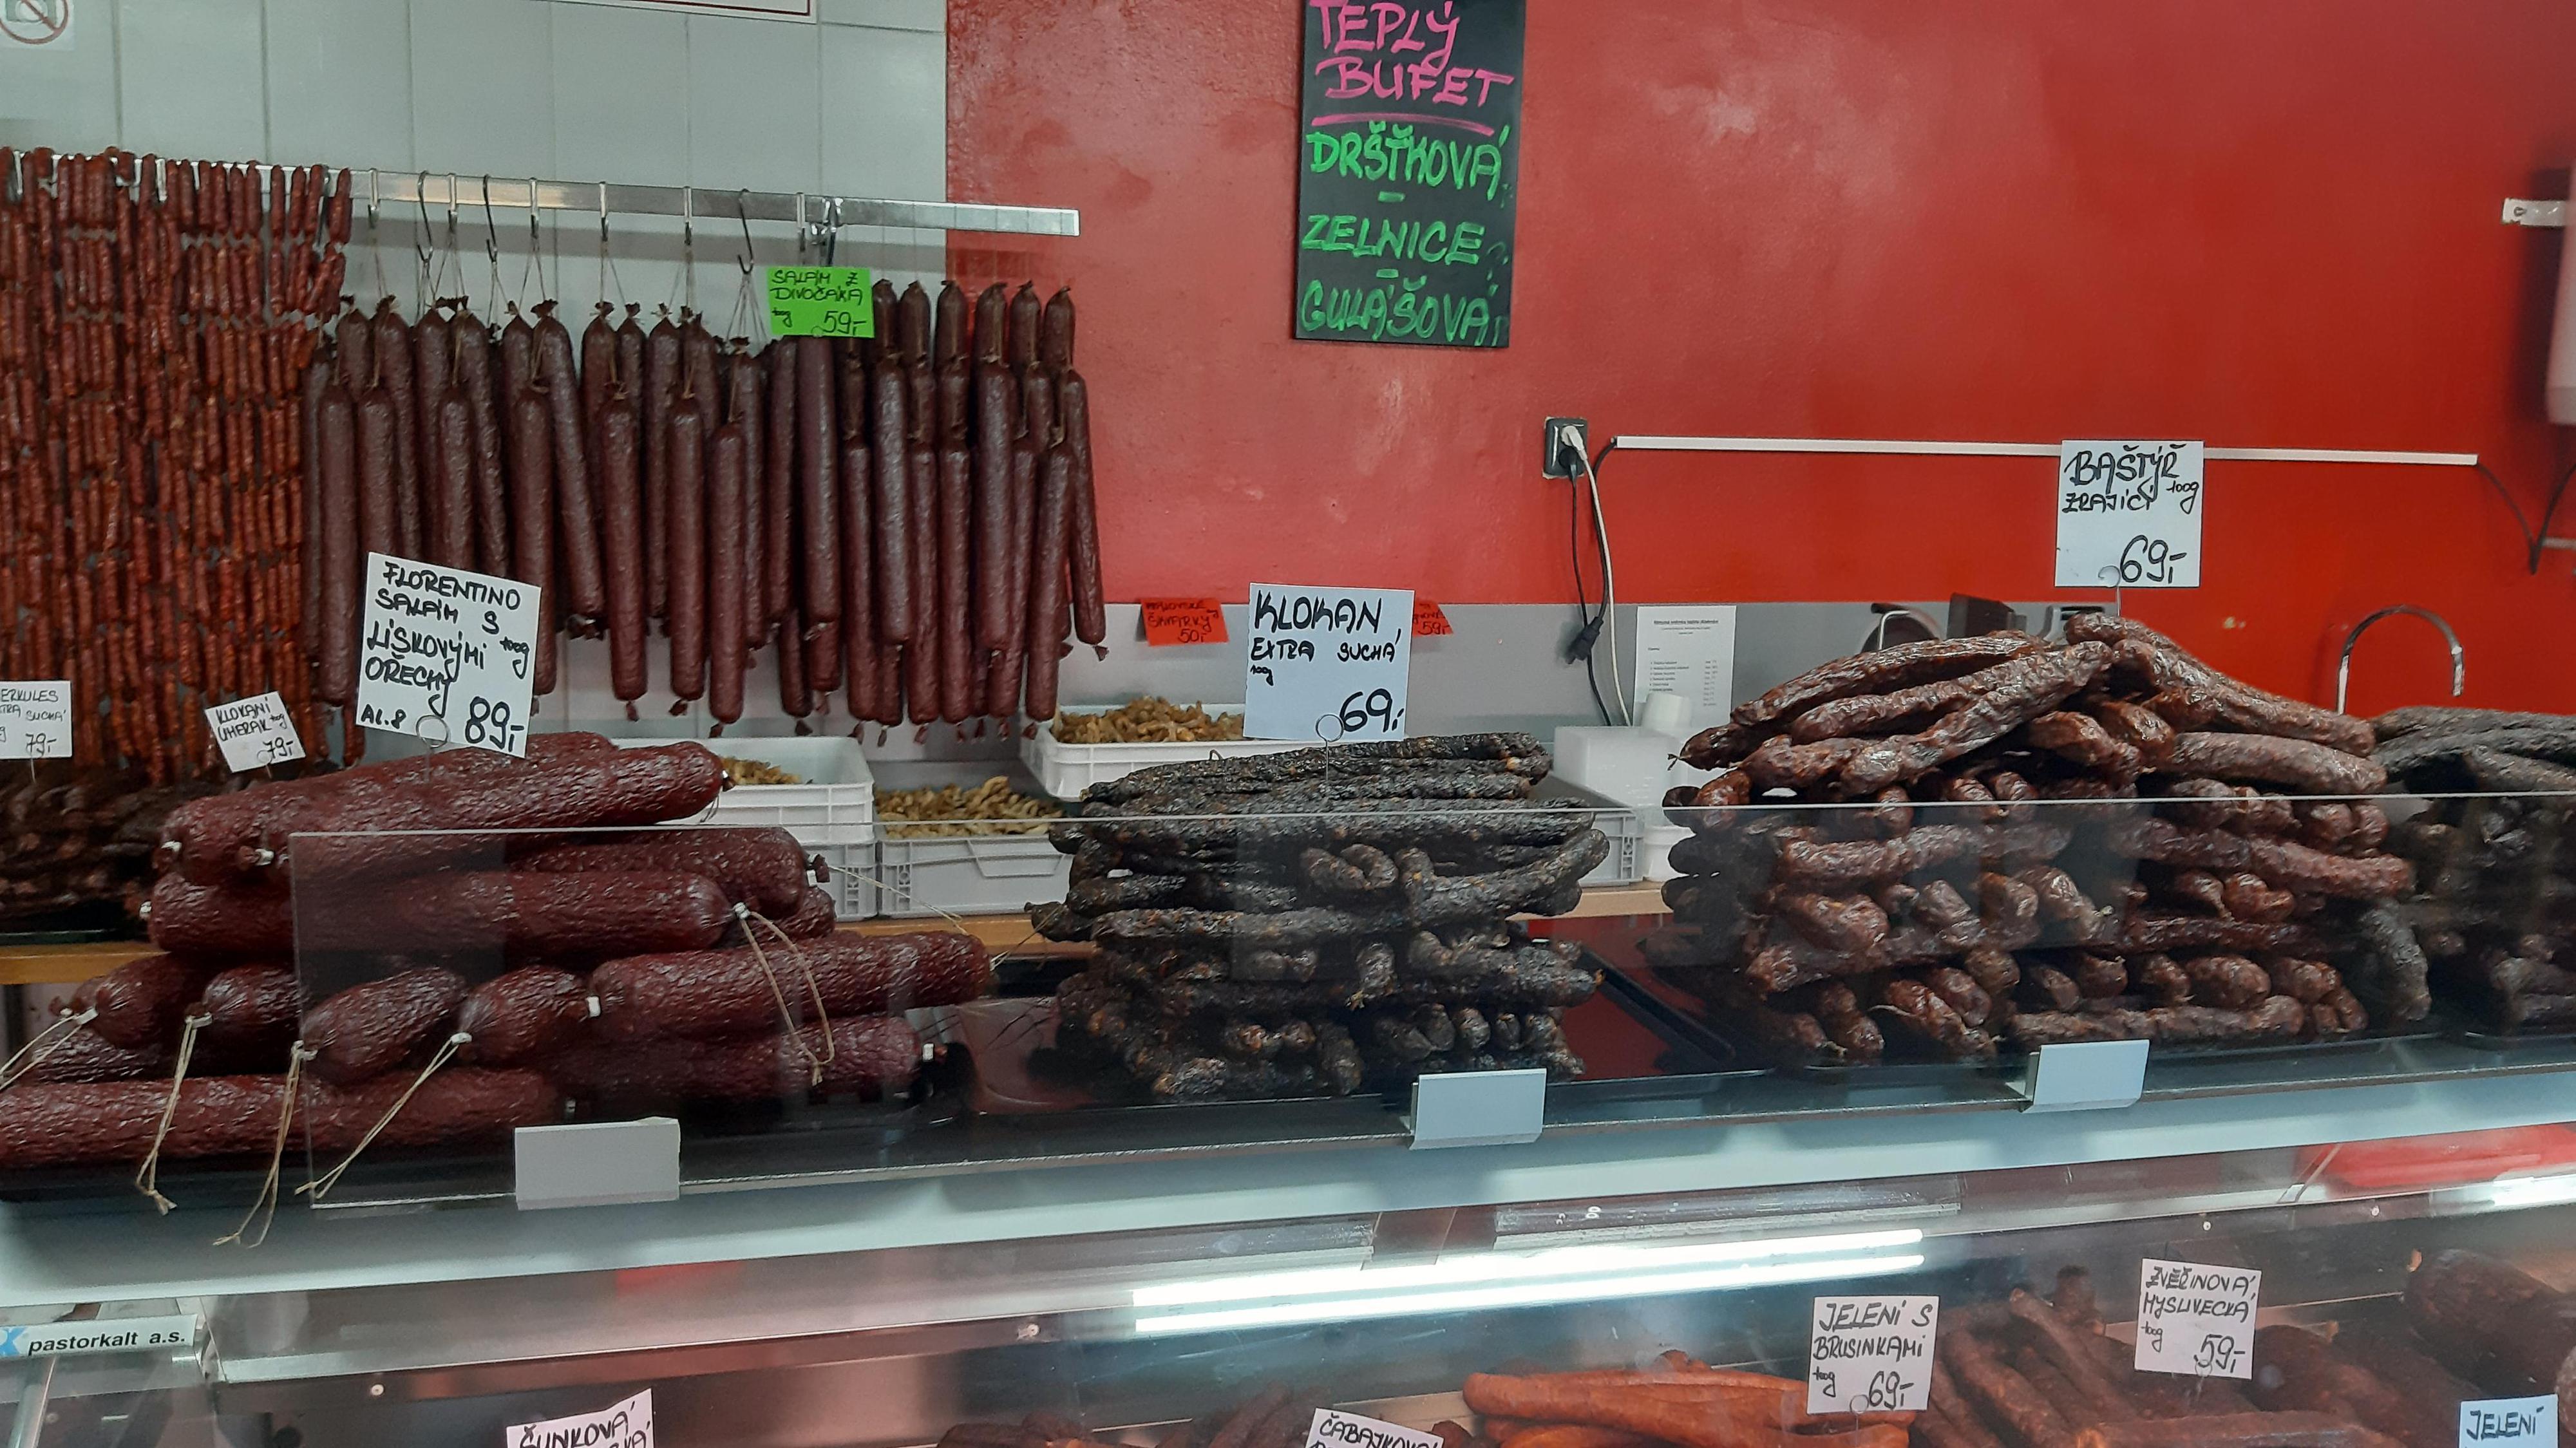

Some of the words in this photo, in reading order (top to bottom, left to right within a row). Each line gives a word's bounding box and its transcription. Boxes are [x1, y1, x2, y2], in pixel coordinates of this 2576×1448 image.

[1309, 0, 1459, 76] TEPLÝ
[1315, 56, 1514, 107] BUFET
[1306, 120, 1510, 201] DRŠŤKOVÁ
[1302, 215, 1484, 265] ZELNICE
[846, 272, 858, 287] Z
[822, 310, 866, 335] 59,-
[1301, 276, 1498, 346] GULÁŠOVÁ
[2064, 444, 2186, 502] BAŠTÝŘ
[2061, 485, 2154, 513] ZRAJÍCÍ
[2166, 480, 2199, 514] 100g
[2119, 534, 2187, 584] 69,-
[383, 561, 521, 610] FLORENTINO
[482, 610, 499, 634] S
[1254, 590, 1383, 634] KLOKAN
[500, 636, 530, 679] 100g
[1250, 637, 1315, 662] EXTRA
[1337, 628, 1401, 663] SUCHÁ
[365, 652, 453, 719] OŘECHY
[1250, 664, 1274, 686] 100g
[0, 688, 59, 702] ERKULES
[216, 696, 271, 725] KLOKANÍ
[26, 710, 66, 722] SUCHÁ
[465, 696, 525, 752] 89,-
[25, 733, 57, 756] 79,-
[263, 737, 294, 759] 79,-
[2146, 1266, 2256, 1297] ZVĚŘINOVÁ
[1819, 1299, 1907, 1333] JELENÍ
[1911, 1304, 1933, 1327] S
[2143, 1292, 2256, 1323] MYSLIVECKÁ
[28, 1331, 138, 1357] pastorkalt
[149, 1331, 185, 1344] a.s.
[1813, 1335, 1926, 1362] BRUSINKAMI
[2141, 1321, 2163, 1353] 100g
[2193, 1334, 2246, 1373] 59,-
[1812, 1366, 1836, 1398] 100g
[1869, 1371, 1915, 1409] 69,-
[2466, 1406, 2544, 1441] JELENÍ
